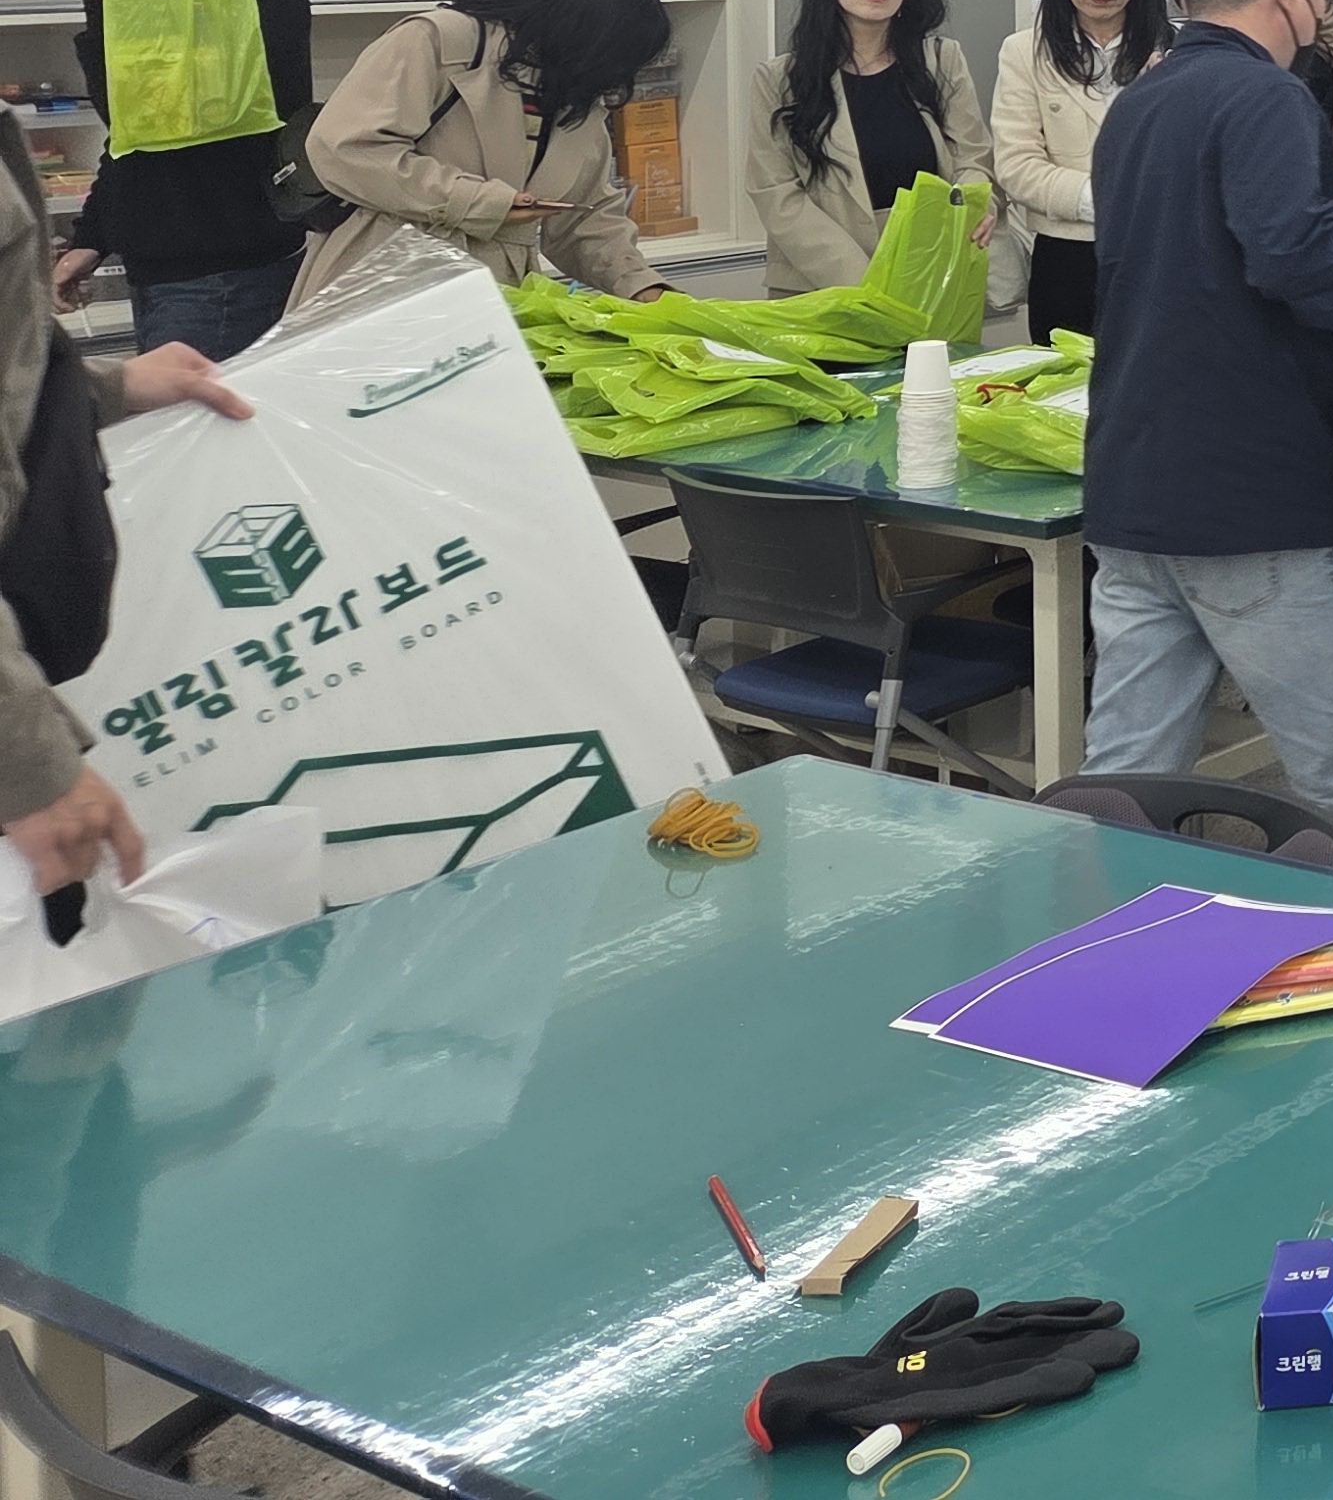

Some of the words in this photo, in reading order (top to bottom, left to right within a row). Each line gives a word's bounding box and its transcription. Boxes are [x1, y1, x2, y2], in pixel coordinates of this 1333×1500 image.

[132, 736, 220, 788] ELIM
[255, 660, 368, 724] COLOR
[399, 590, 504, 651] BOARD
